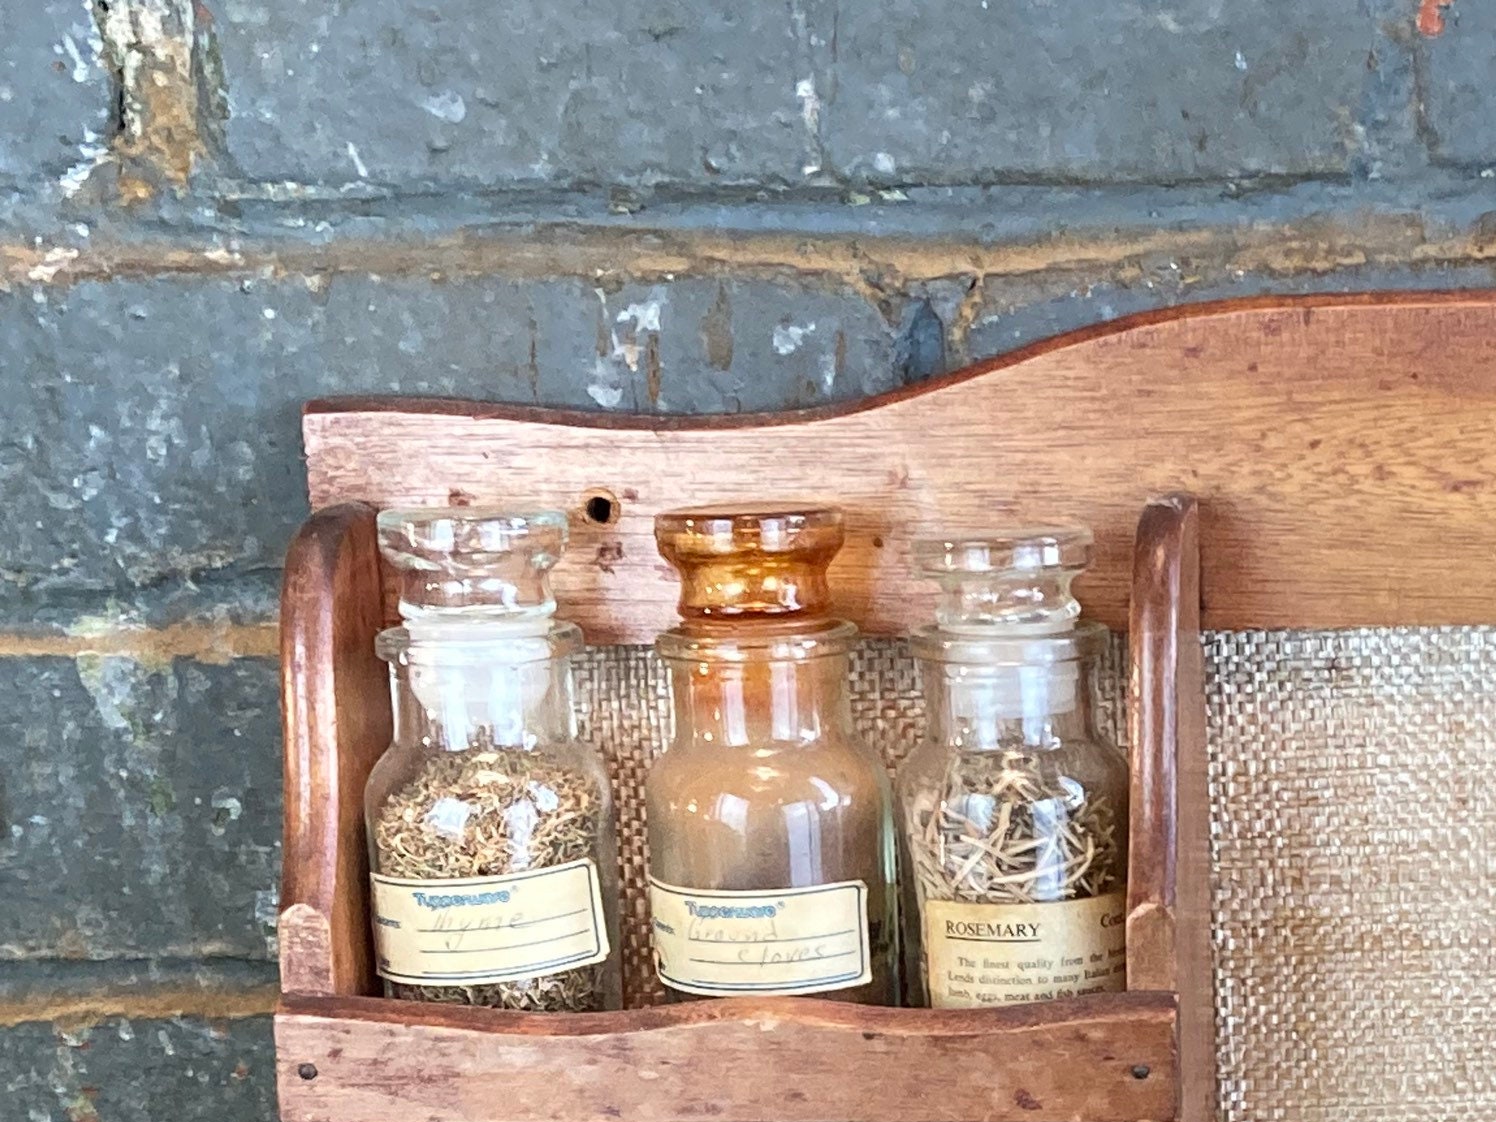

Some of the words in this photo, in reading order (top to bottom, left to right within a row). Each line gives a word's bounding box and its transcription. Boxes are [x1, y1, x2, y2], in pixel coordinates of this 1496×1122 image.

[945, 919, 1041, 938] ROSEMARY
[957, 956, 976, 968] The
[1017, 958, 1053, 972] quality
